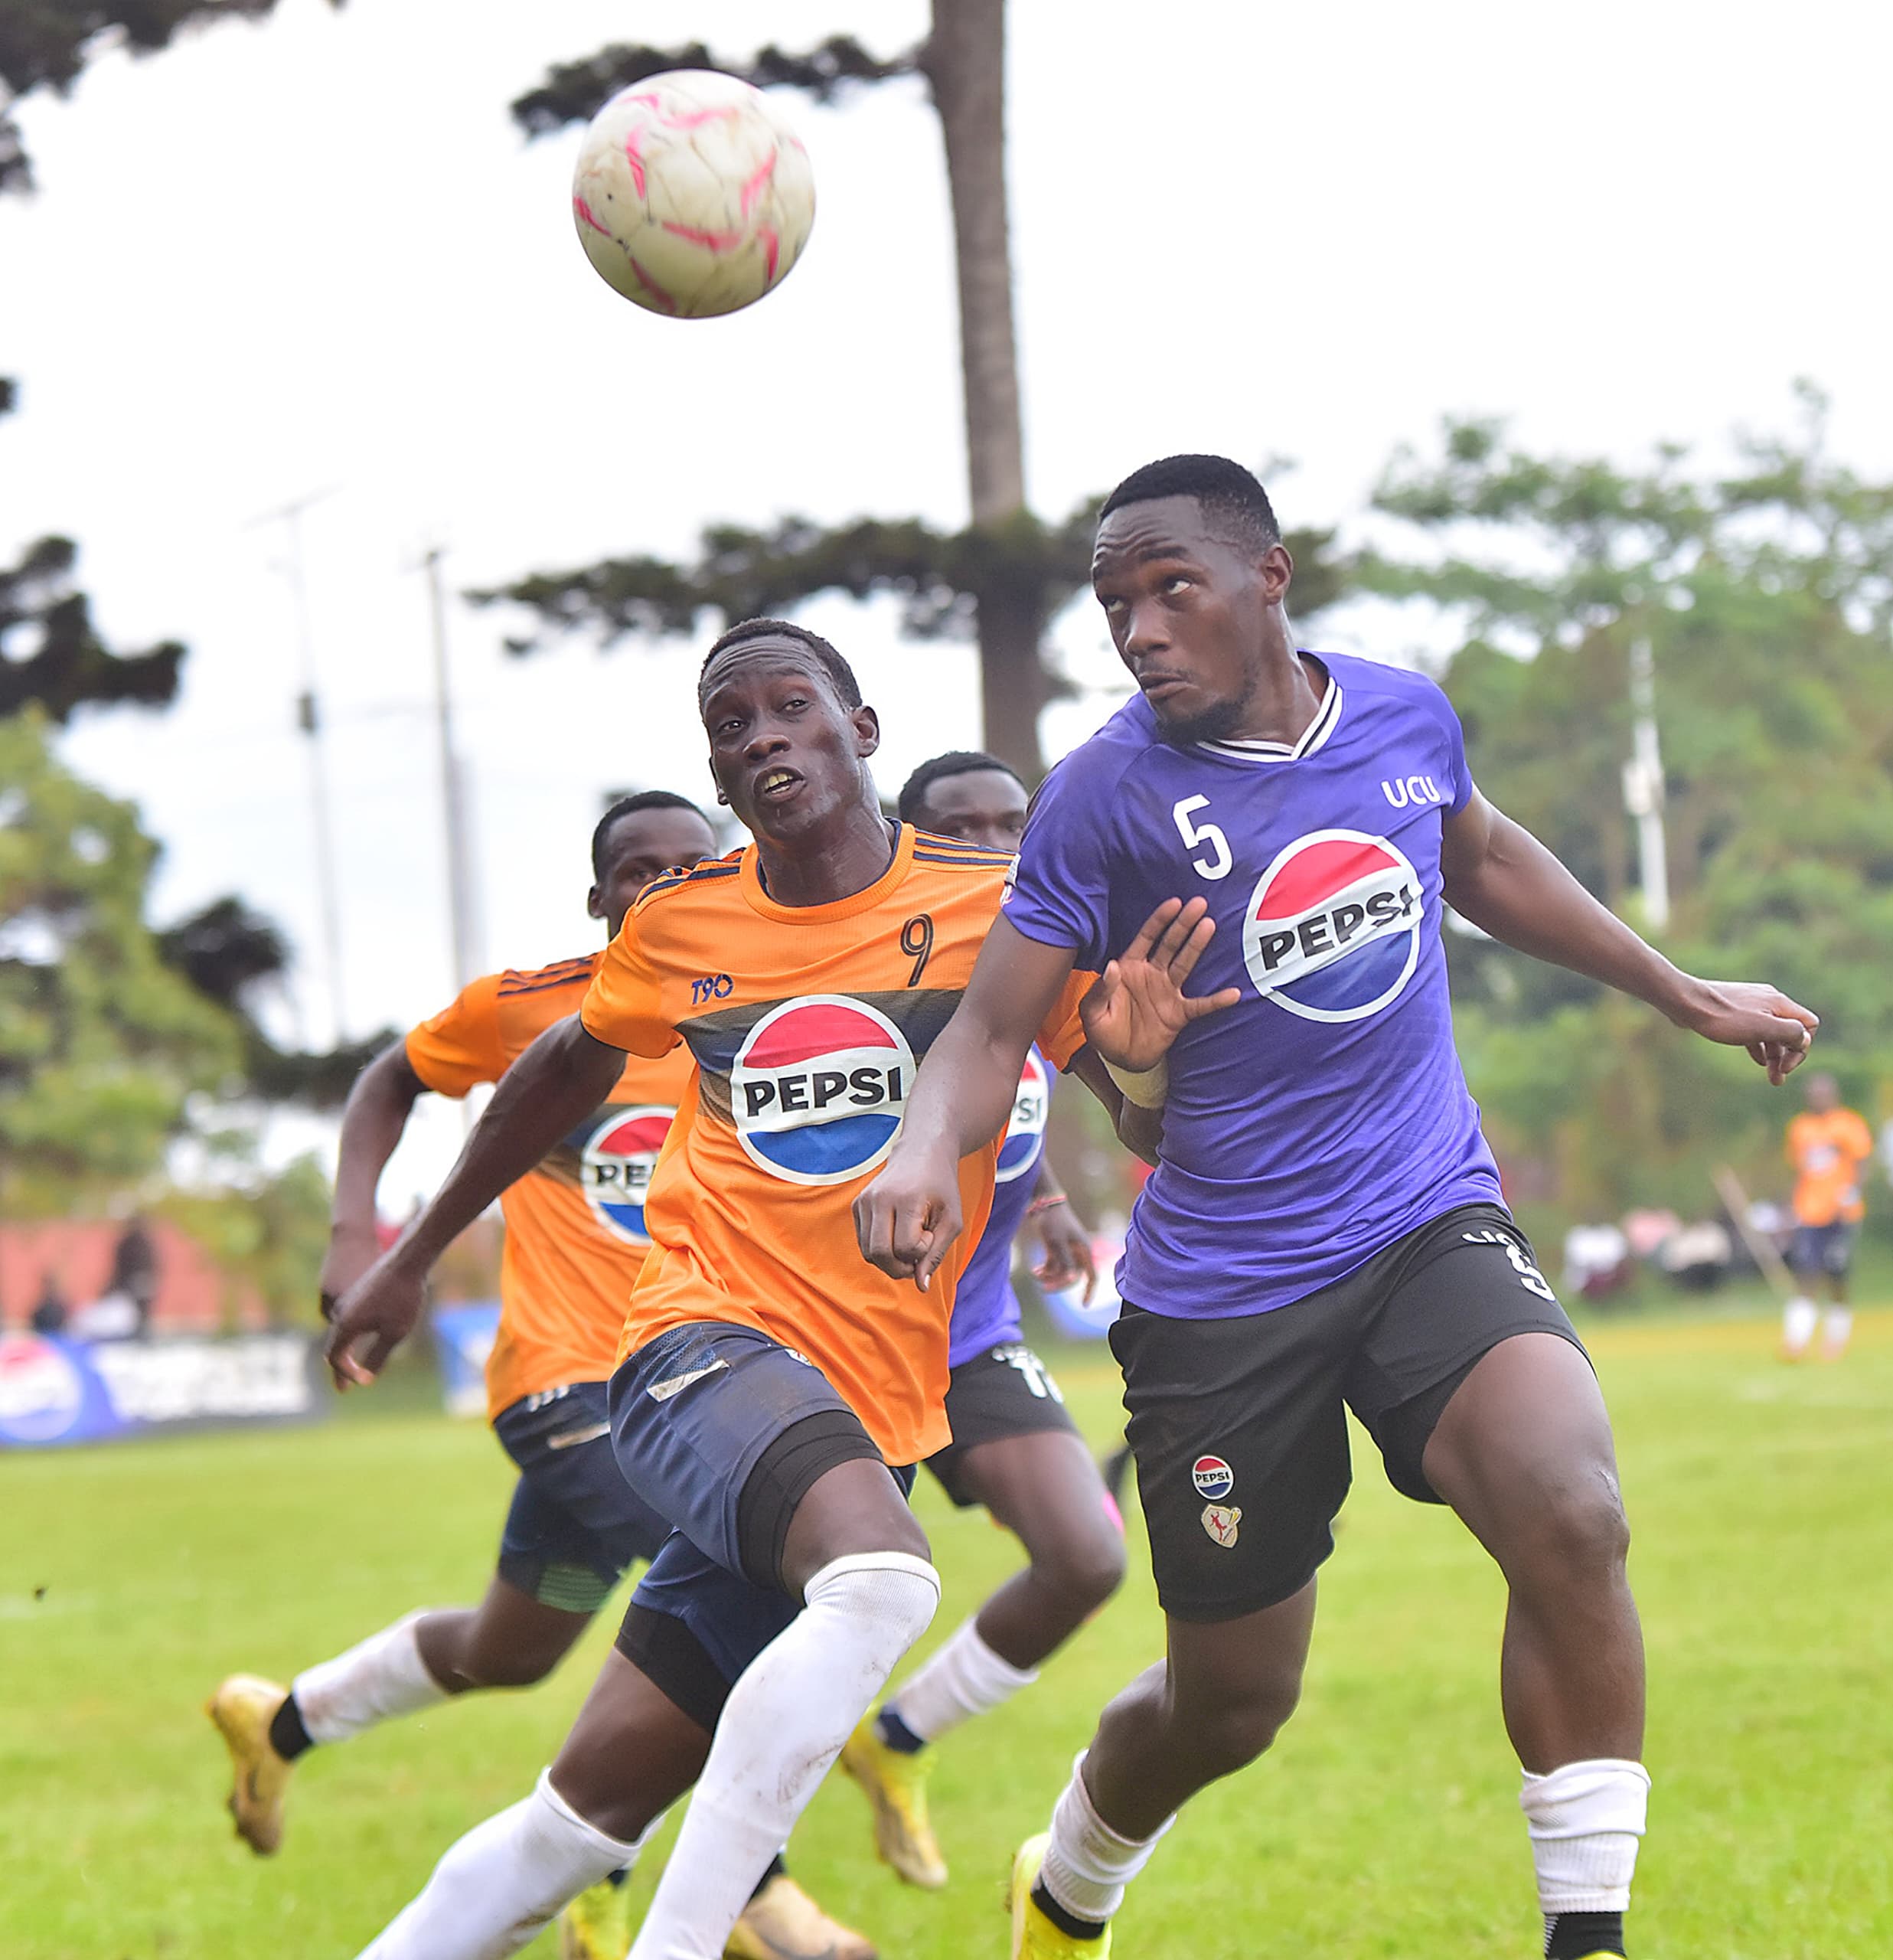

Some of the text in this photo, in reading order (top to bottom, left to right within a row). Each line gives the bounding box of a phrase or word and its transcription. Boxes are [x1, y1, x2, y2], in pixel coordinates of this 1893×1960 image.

[1381, 776, 1441, 808] UCU
[1173, 793, 1233, 880] 5
[899, 913, 934, 988] 9
[1258, 884, 1413, 971] PEPSI
[743, 1066, 902, 1118] PEPSI
[1196, 1472, 1230, 1483] PEPSI
